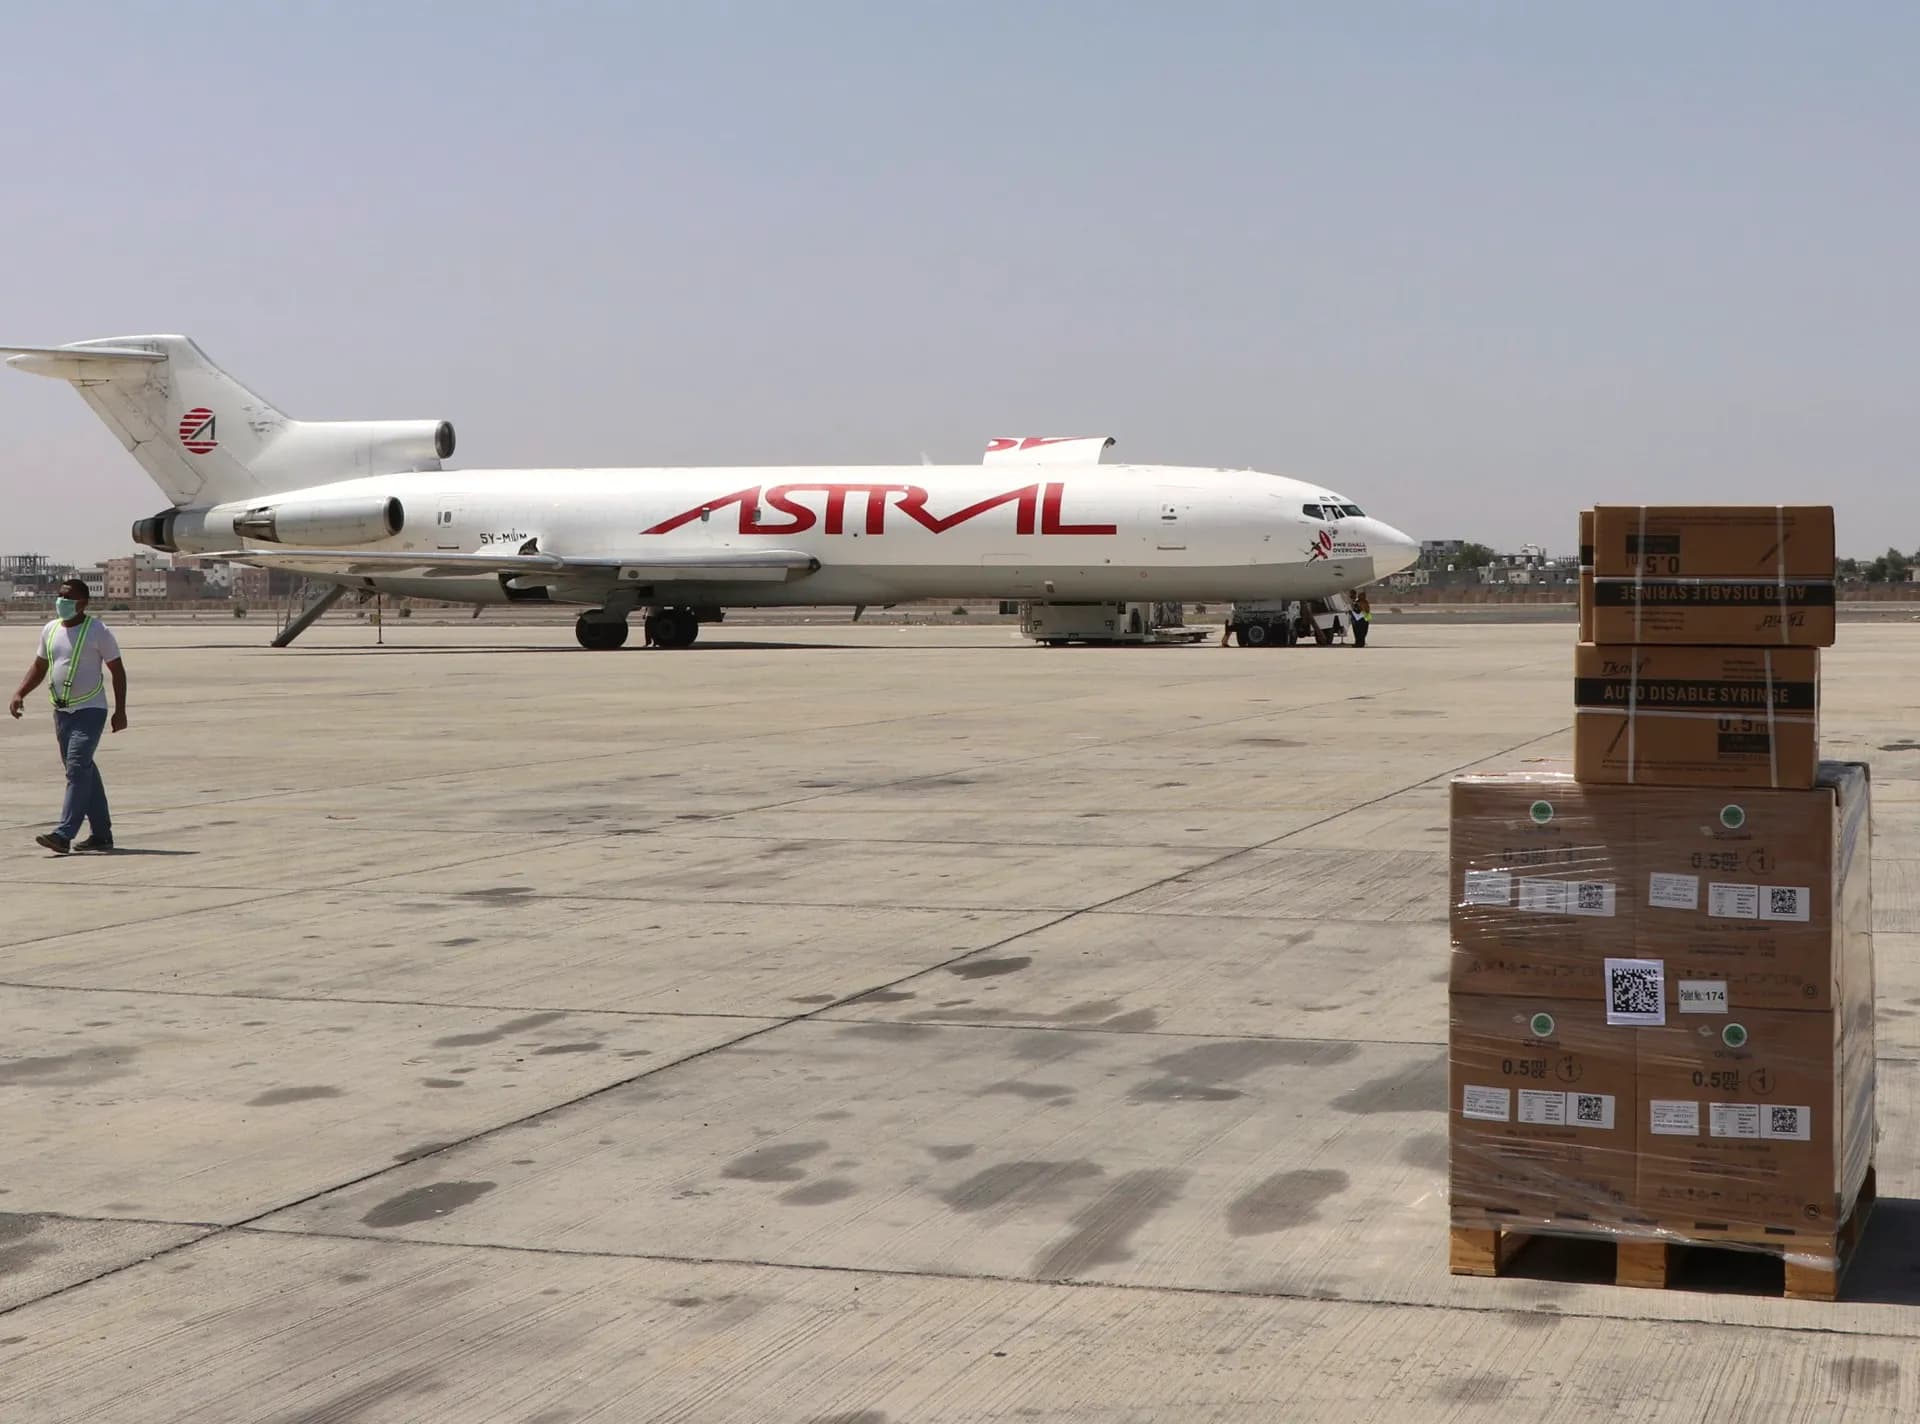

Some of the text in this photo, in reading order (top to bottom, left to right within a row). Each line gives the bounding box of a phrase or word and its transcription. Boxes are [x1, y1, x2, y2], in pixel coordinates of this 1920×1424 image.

[639, 482, 1117, 536] ASTRAL
[1645, 556, 1681, 574] 0.5
[1619, 585, 1688, 601] SYRINGE
[1692, 585, 1759, 601] DISABLE
[1651, 685, 1717, 702] DISABLE
[1720, 686, 1789, 703] SYRINGE
[1691, 852, 1720, 869] 0.5
[1705, 991, 1724, 1001] 174
[1502, 1058, 1530, 1075] 0.5
[1692, 1069, 1721, 1088] 0.5
